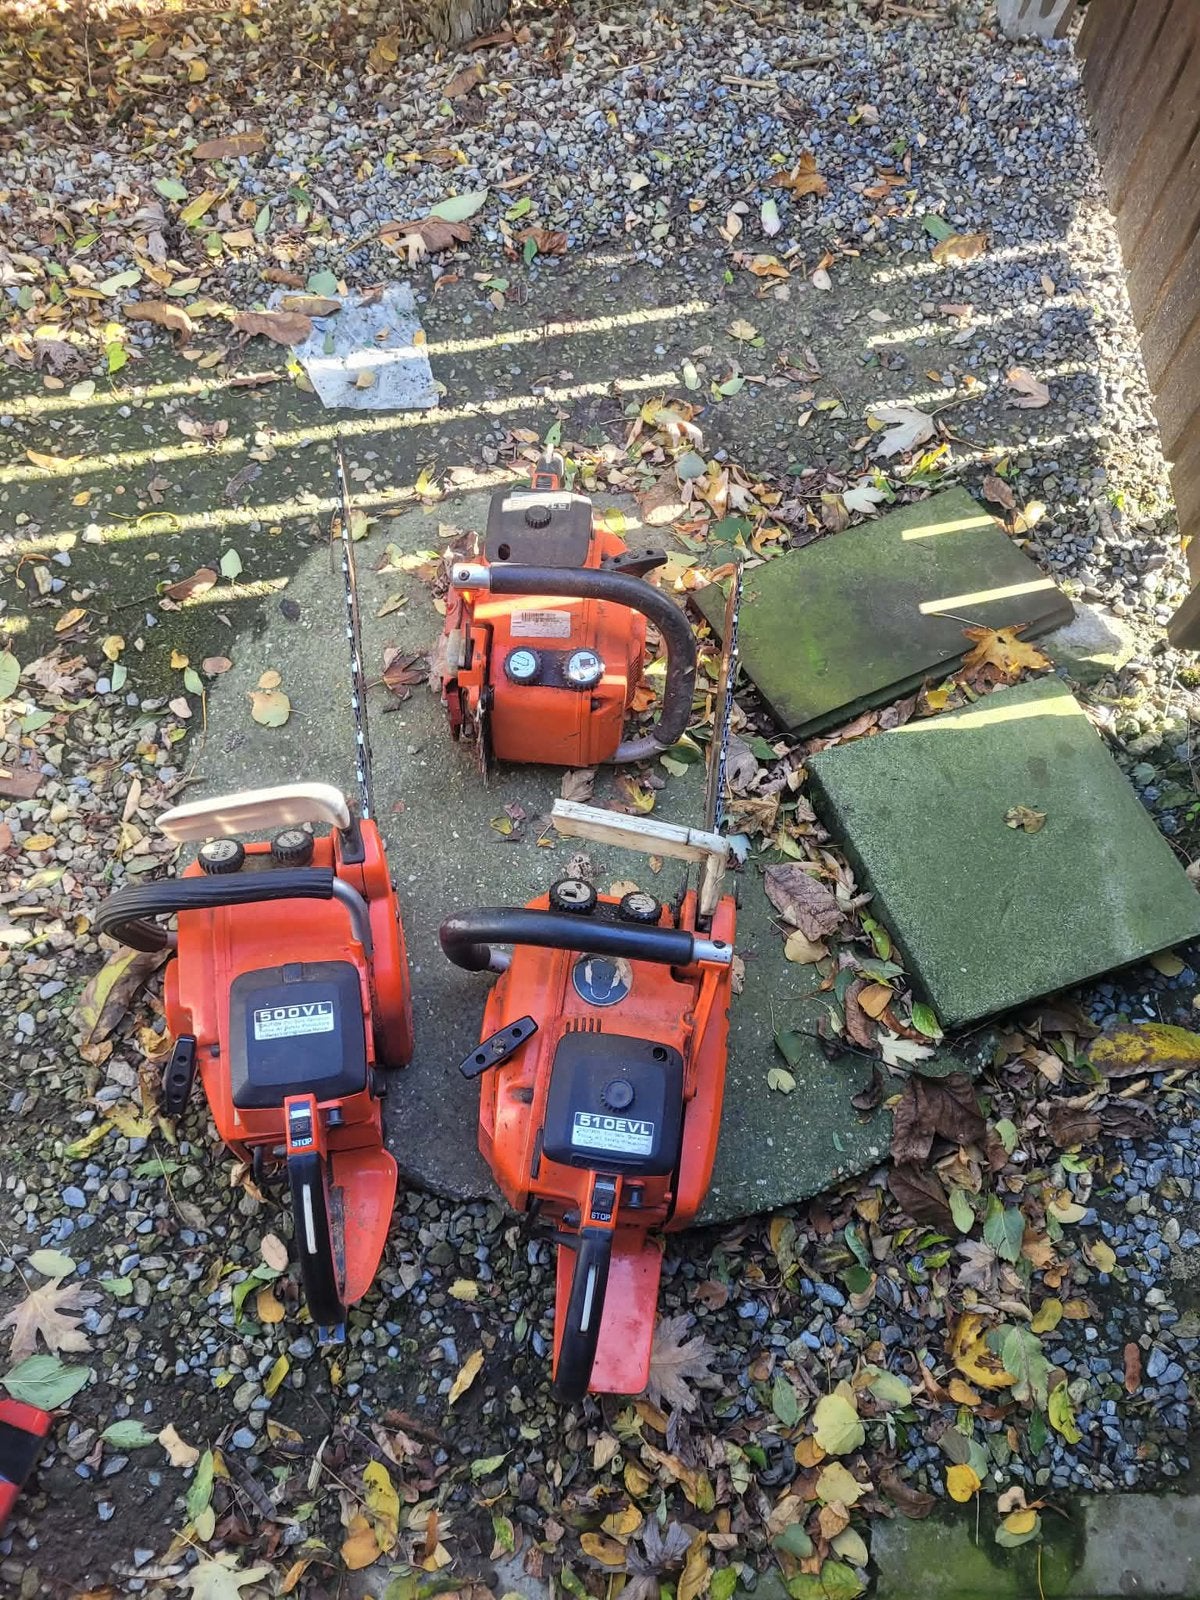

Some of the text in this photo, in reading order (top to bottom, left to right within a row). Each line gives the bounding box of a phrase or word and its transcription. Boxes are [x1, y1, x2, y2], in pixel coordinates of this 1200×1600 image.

[260, 1004, 328, 1022] 500VL
[579, 1114, 650, 1135] 510EVL
[292, 1137, 312, 1147] STOP
[591, 1211, 611, 1221] STOP
